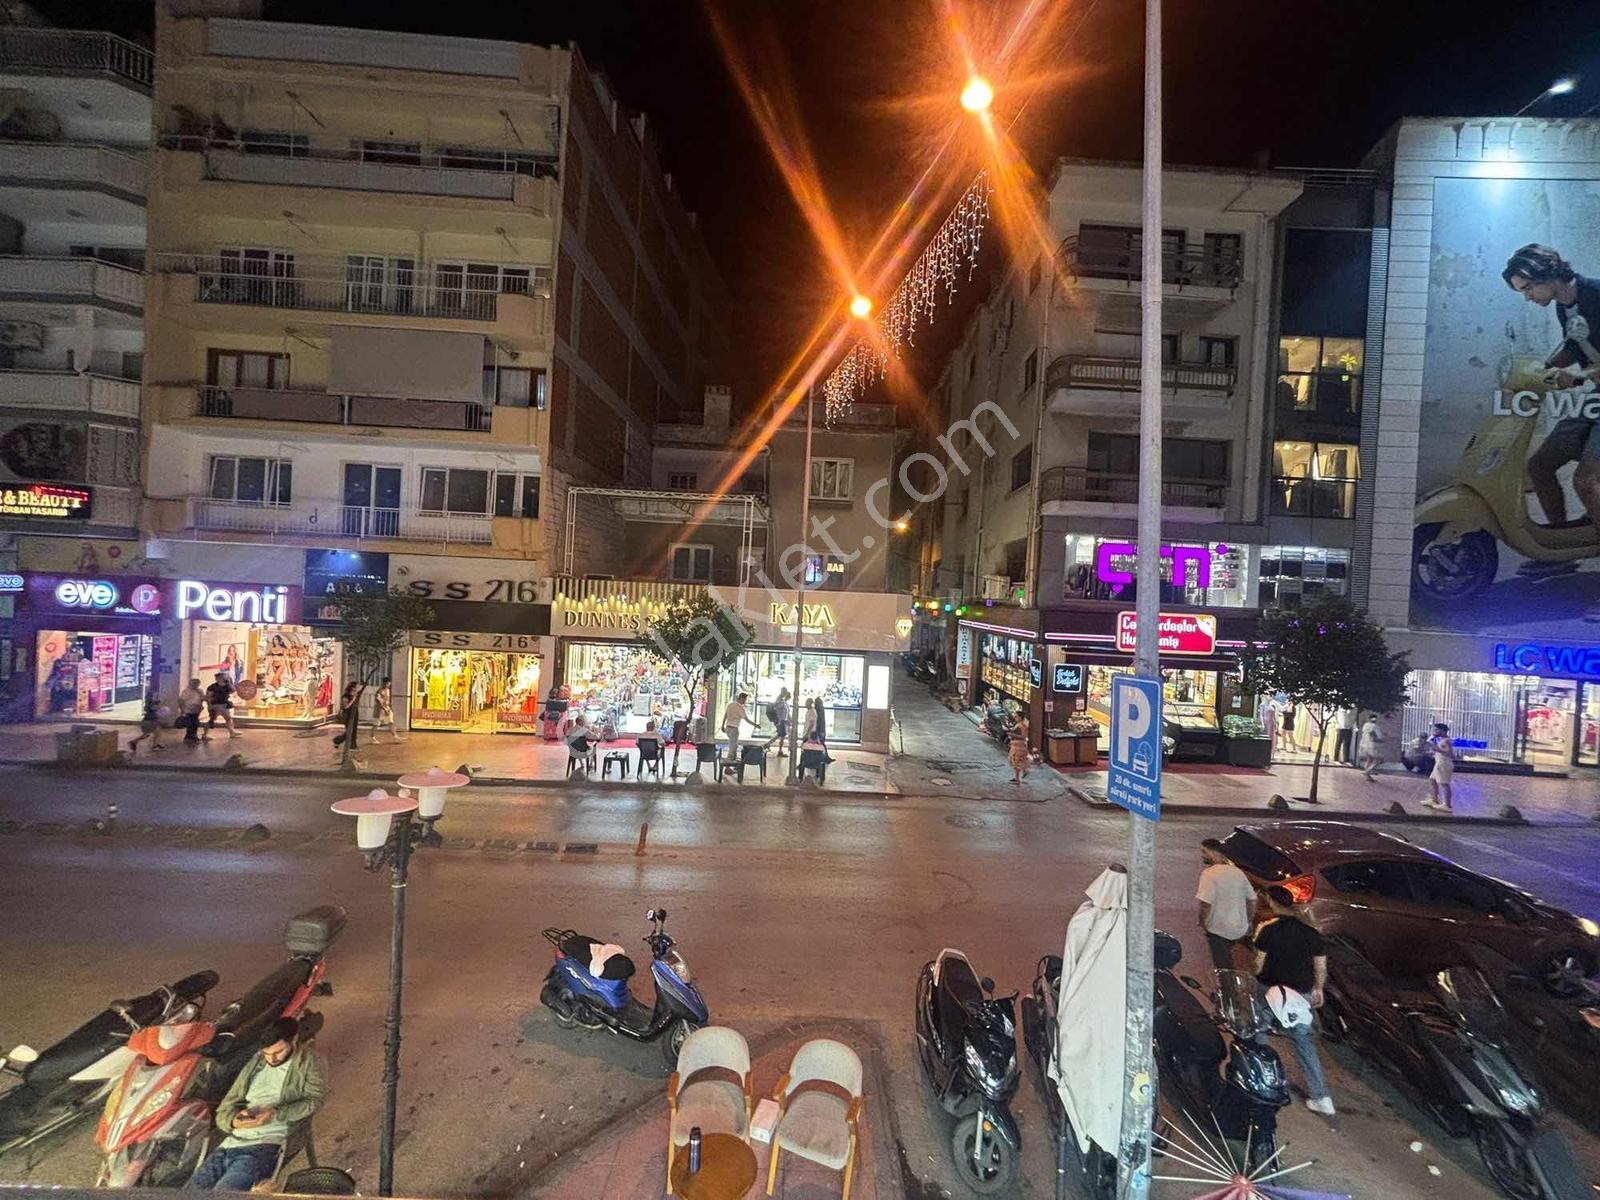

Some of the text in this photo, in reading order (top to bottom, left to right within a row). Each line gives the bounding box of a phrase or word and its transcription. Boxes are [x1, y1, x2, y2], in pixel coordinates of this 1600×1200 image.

[1494, 390, 1540, 417] LC
[4, 490, 81, 508] & BEAUTY
[57, 581, 116, 607] eve
[176, 580, 289, 623] Penti
[485, 579, 537, 602] 216
[565, 610, 640, 630] DUNNES
[770, 603, 835, 628] KAYA
[493, 636, 528, 649] 216
[1496, 643, 1541, 671] LC
[1118, 685, 1151, 764] P
